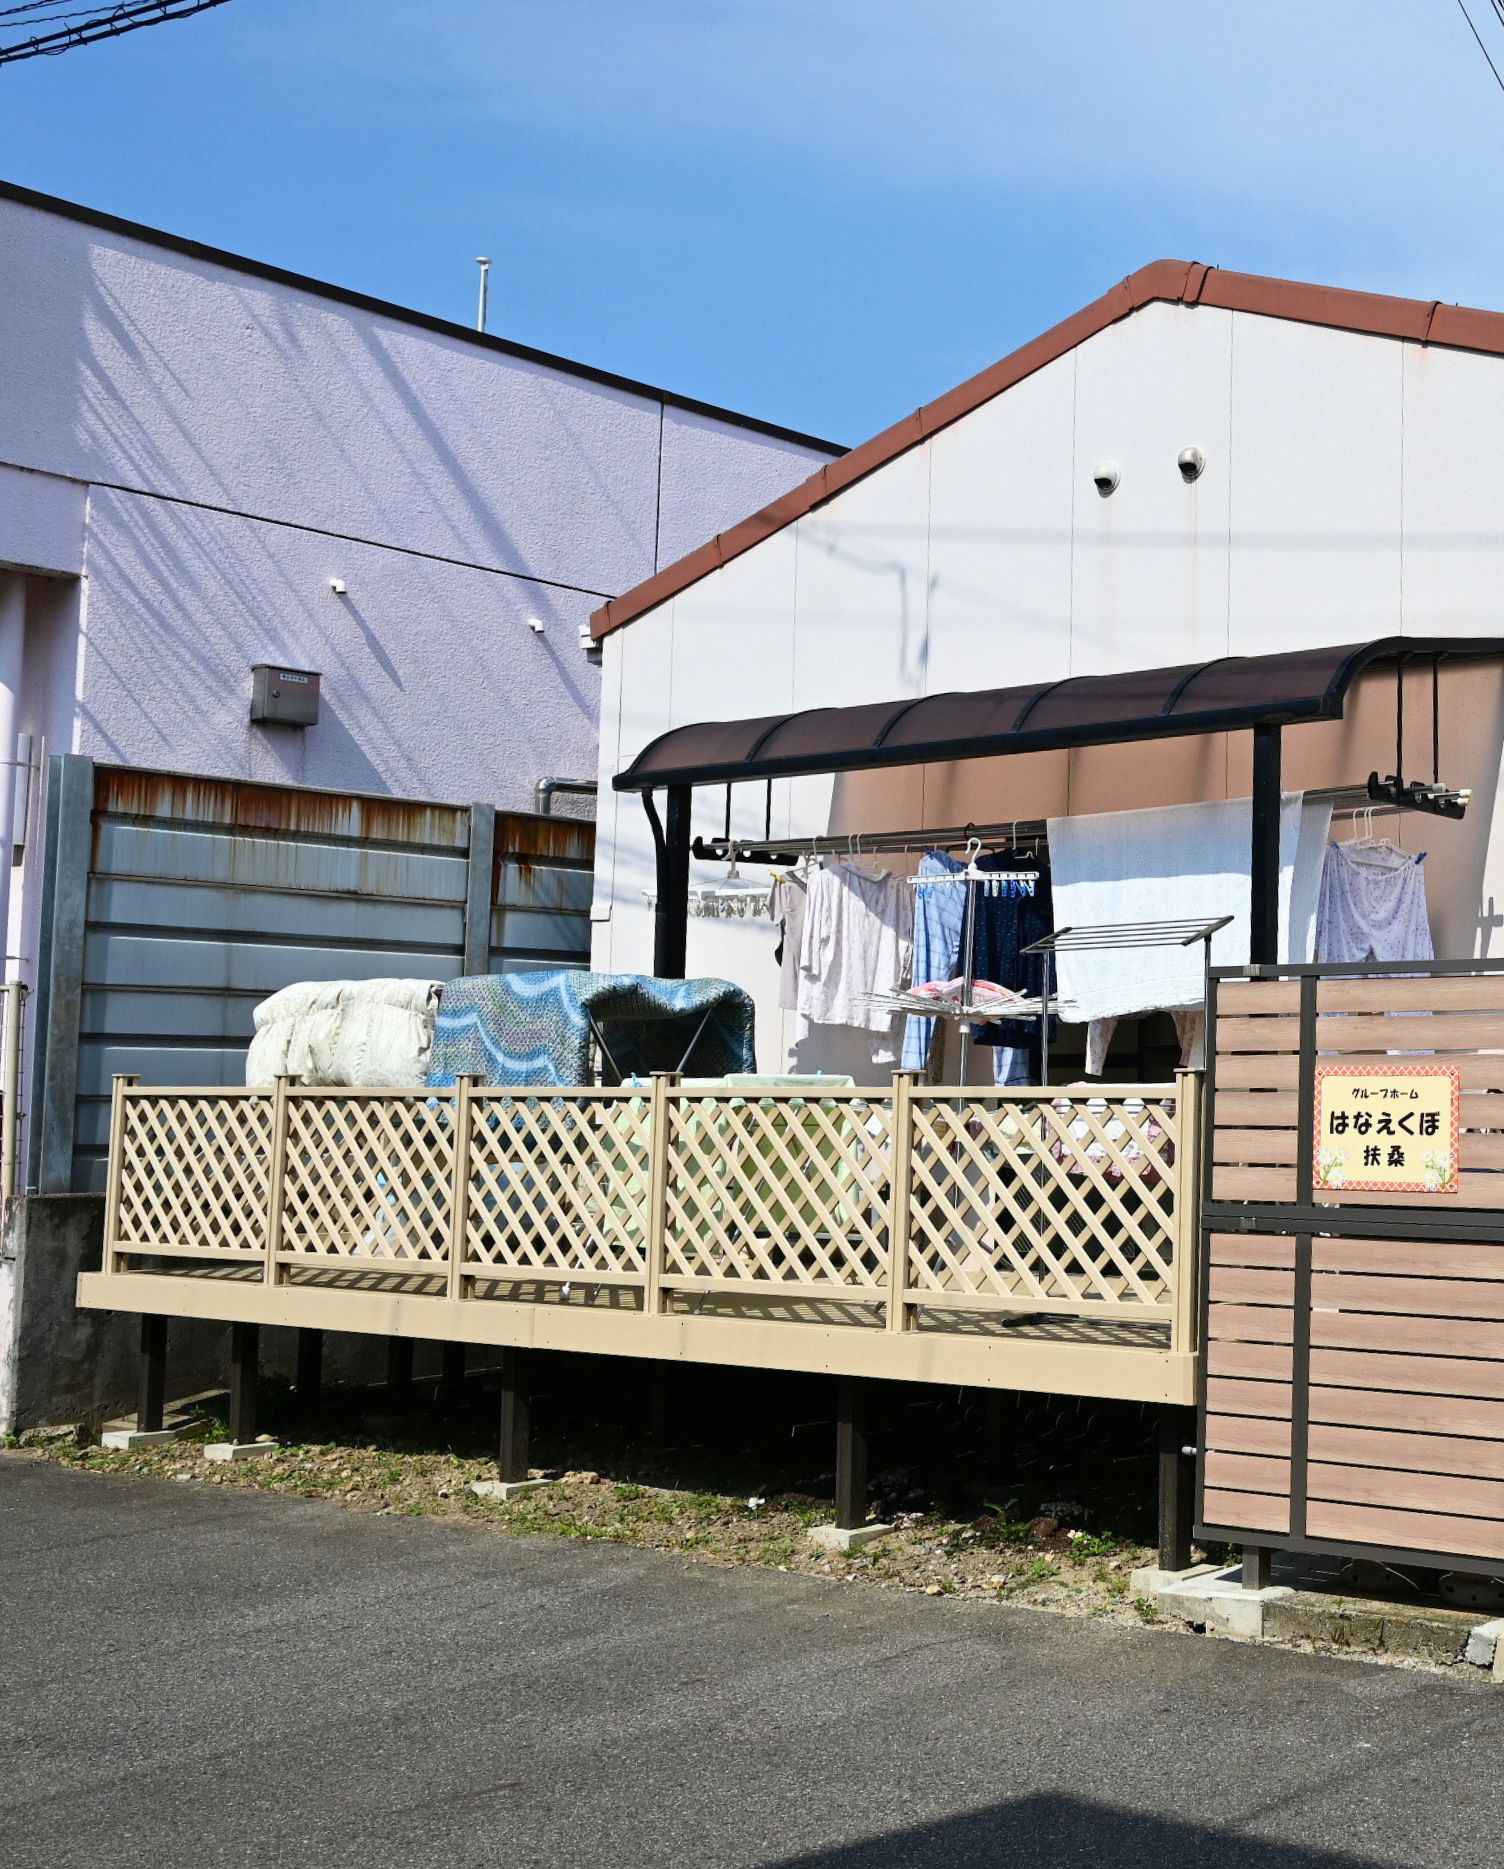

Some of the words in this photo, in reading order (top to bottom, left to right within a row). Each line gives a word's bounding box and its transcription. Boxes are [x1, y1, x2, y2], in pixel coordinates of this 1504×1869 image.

[1329, 1110, 1440, 1136] はなえくぼ
[1363, 1144, 1406, 1168] 扶桑
